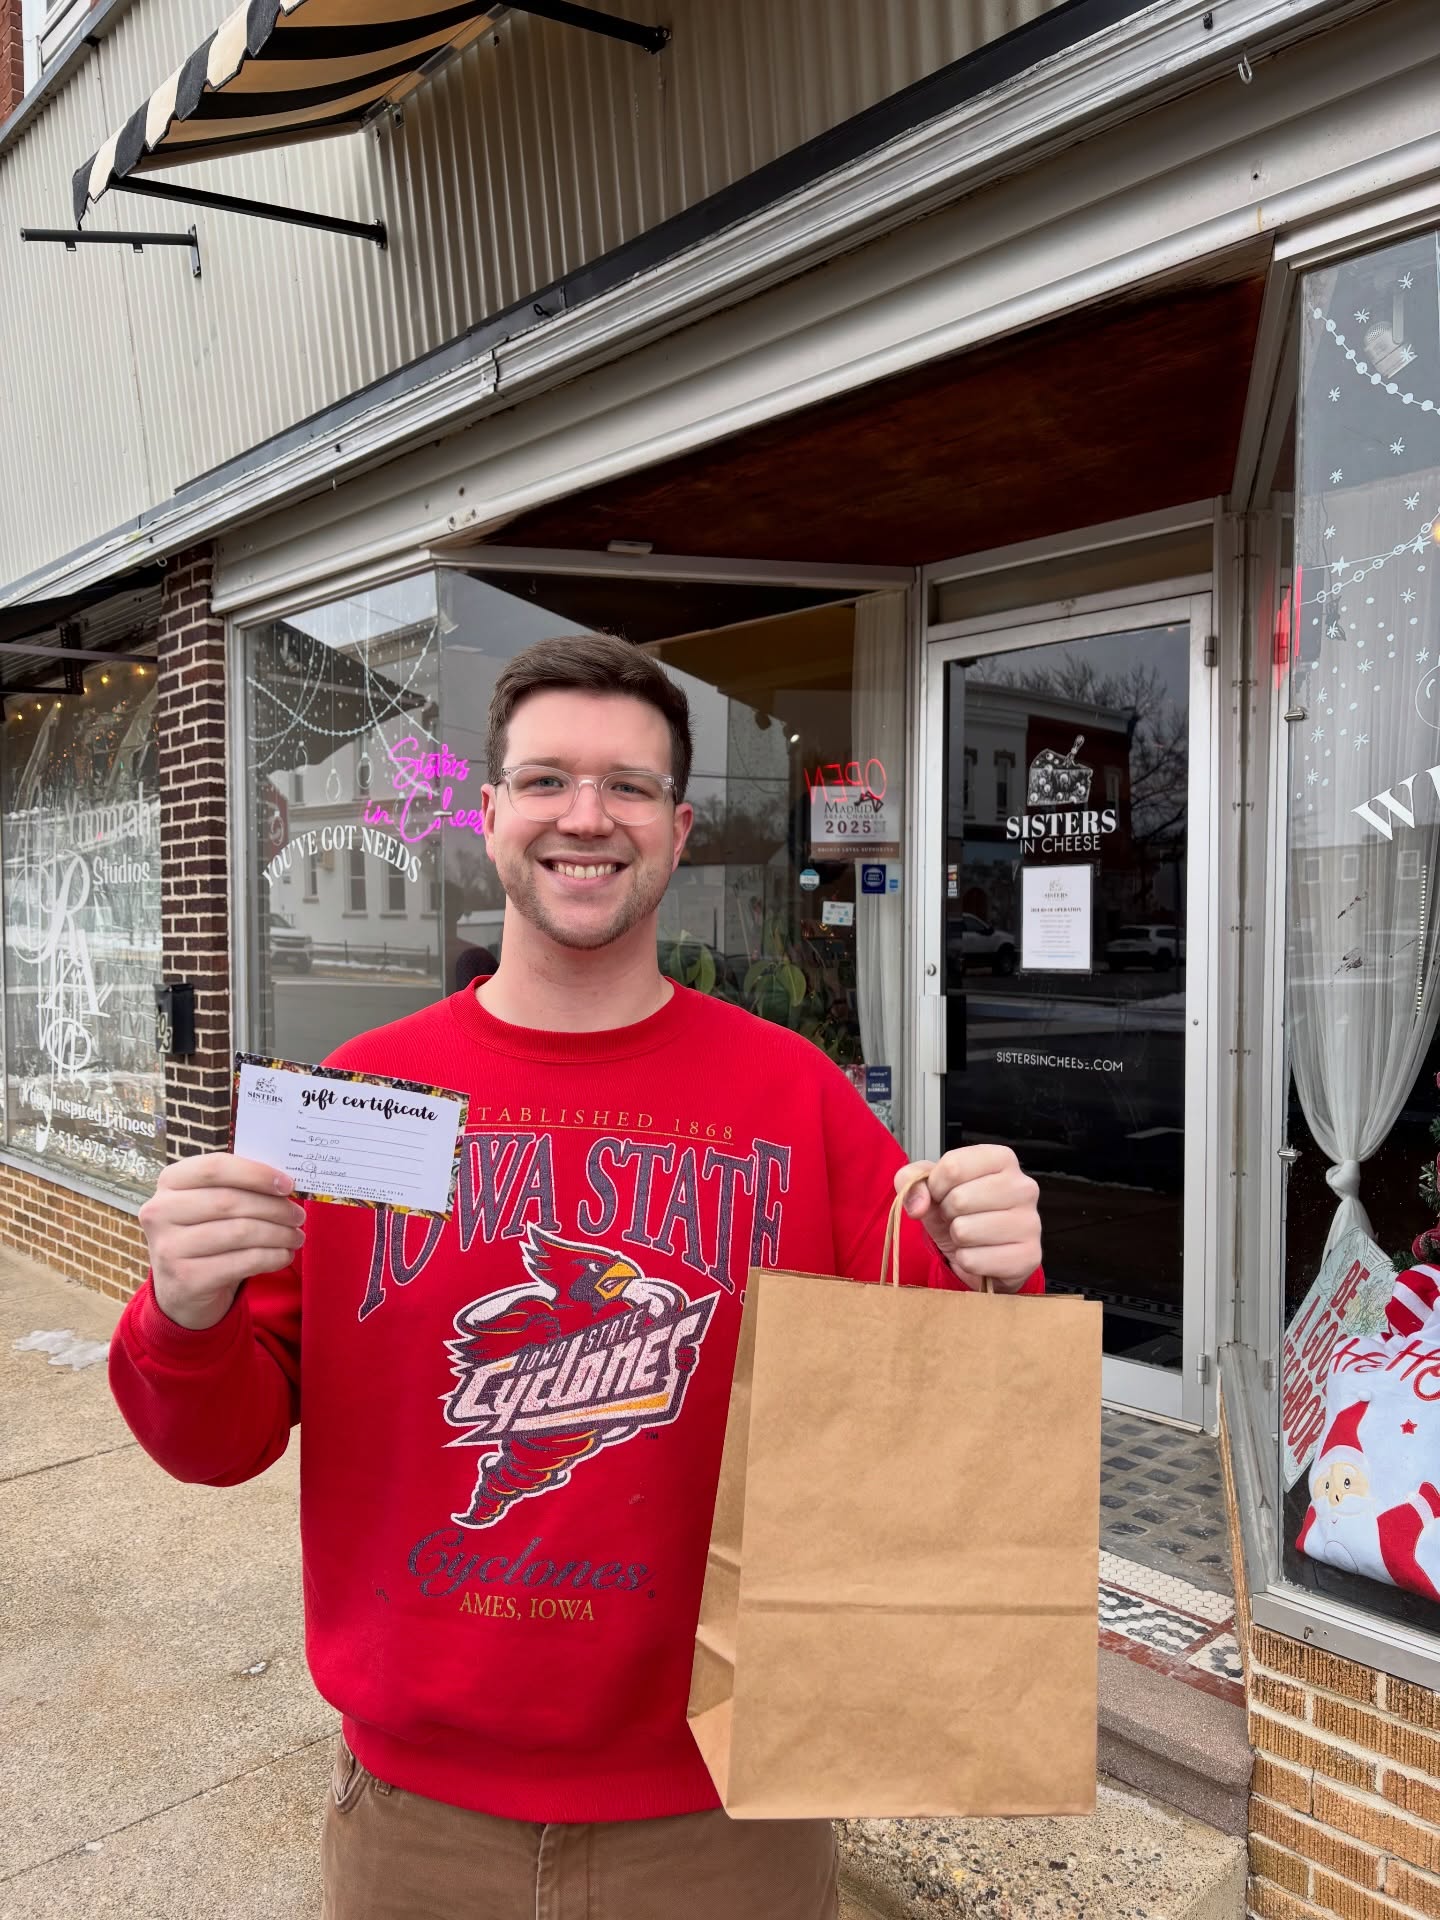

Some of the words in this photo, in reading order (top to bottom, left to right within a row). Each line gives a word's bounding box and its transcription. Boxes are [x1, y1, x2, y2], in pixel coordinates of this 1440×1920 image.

[388, 736, 470, 789] Sisters
[363, 800, 394, 824] in
[400, 781, 485, 843] Chees
[825, 820, 871, 834] 2025
[1006, 809, 1117, 840] SISTERS
[1350, 765, 1440, 840] W
[92, 854, 150, 885] Studios
[262, 830, 318, 889] YOU'VE
[321, 825, 357, 851] GOT
[360, 826, 422, 883] NEEDS
[1019, 839, 1035, 855] IN
[1041, 835, 1102, 854] CHEESE
[247, 1091, 283, 1103] SISTERS
[301, 1088, 338, 1110] gift
[342, 1095, 438, 1121] certificate
[477, 1106, 653, 1128] TABLISHED
[673, 1118, 733, 1140] 1868
[578, 1137, 791, 1305] STATE
[1330, 1259, 1370, 1321] BE
[520, 1342, 564, 1372] IOWA
[585, 1308, 643, 1351] STATE
[1293, 1296, 1321, 1343] A
[1302, 1310, 1348, 1398] GOO
[407, 1527, 656, 1598] Cyclones
[459, 1591, 521, 1620] AMES,
[530, 1598, 595, 1621] IOWA
